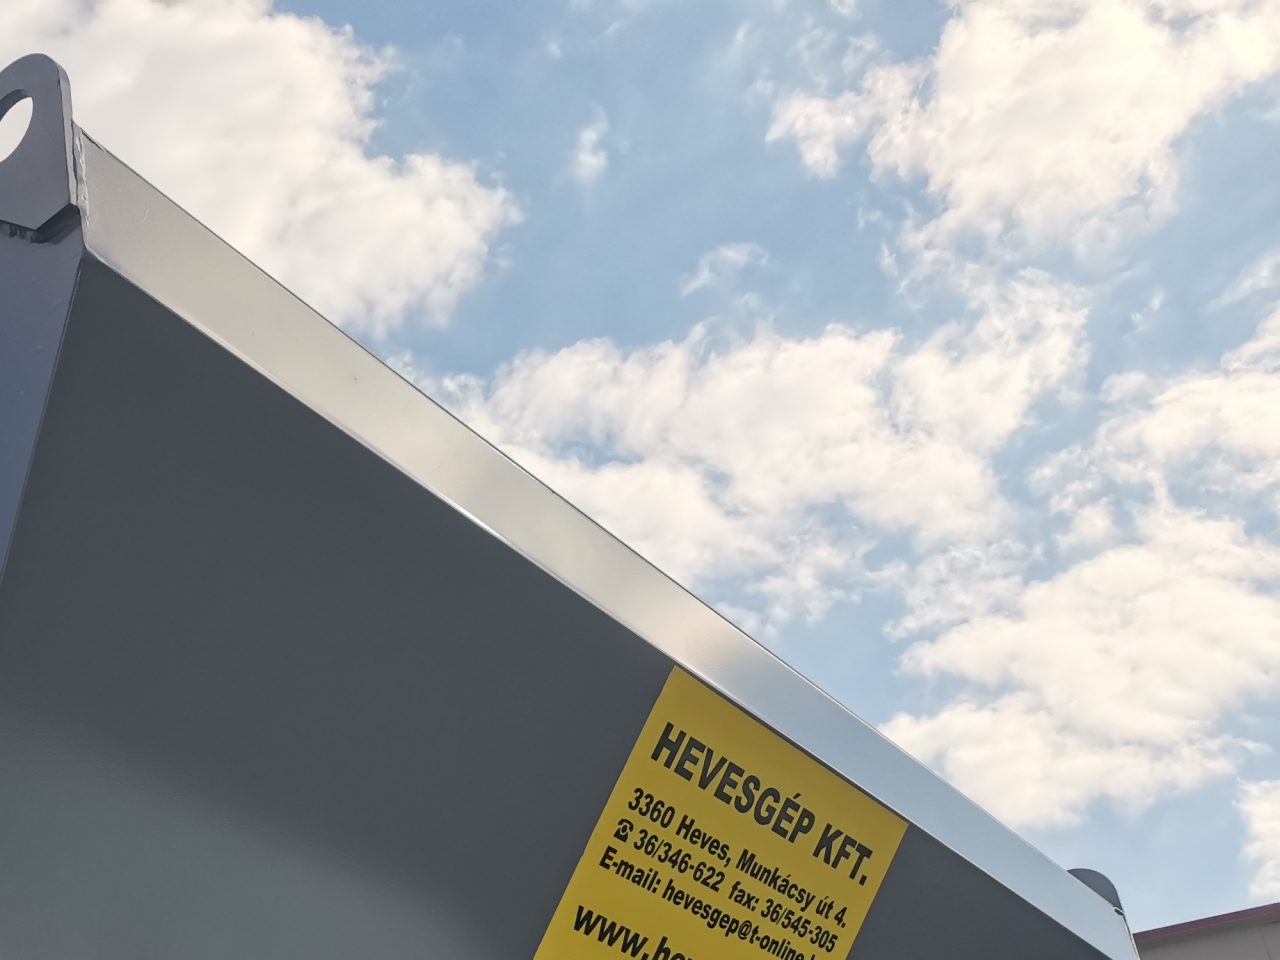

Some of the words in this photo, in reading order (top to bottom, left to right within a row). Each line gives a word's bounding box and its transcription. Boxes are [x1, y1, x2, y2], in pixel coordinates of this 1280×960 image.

[598, 845, 662, 894] E-mail:
[627, 787, 676, 829] 3360
[674, 814, 732, 869] Heves,
[735, 848, 817, 913] Munkácsy
[815, 895, 835, 920] út
[833, 906, 848, 929] 4.
[650, 721, 816, 844] HEVESGÉP
[812, 822, 874, 887] KFT.
[633, 828, 726, 893] 36/346-622
[728, 880, 761, 913] fax:
[760, 897, 839, 953] 36/545-305
